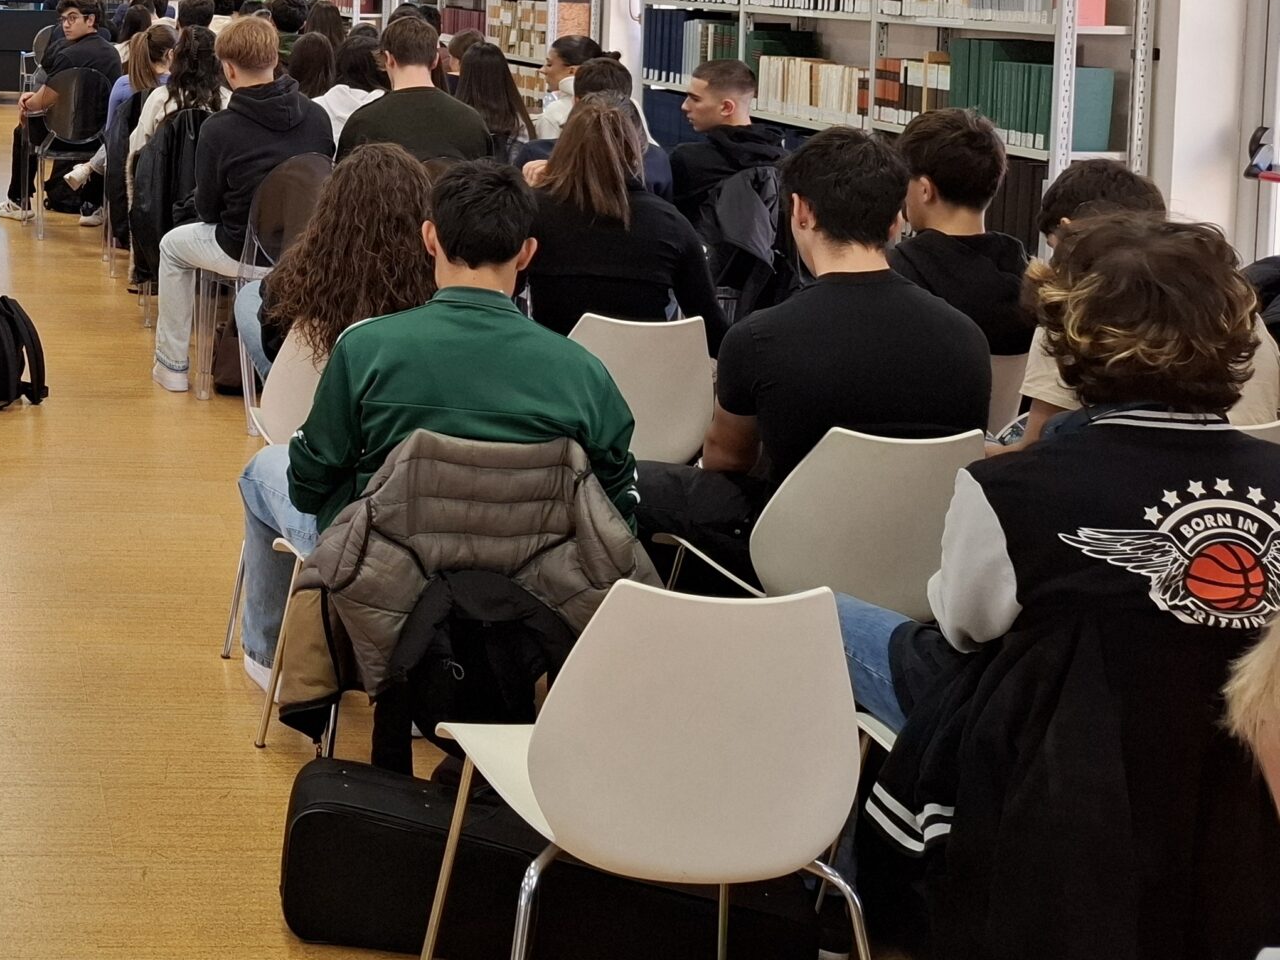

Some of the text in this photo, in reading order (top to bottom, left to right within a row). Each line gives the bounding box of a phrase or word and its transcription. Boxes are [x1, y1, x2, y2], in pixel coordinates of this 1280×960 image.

[1180, 513, 1259, 538] BORN IN
[1183, 608, 1266, 629] RITAIN
